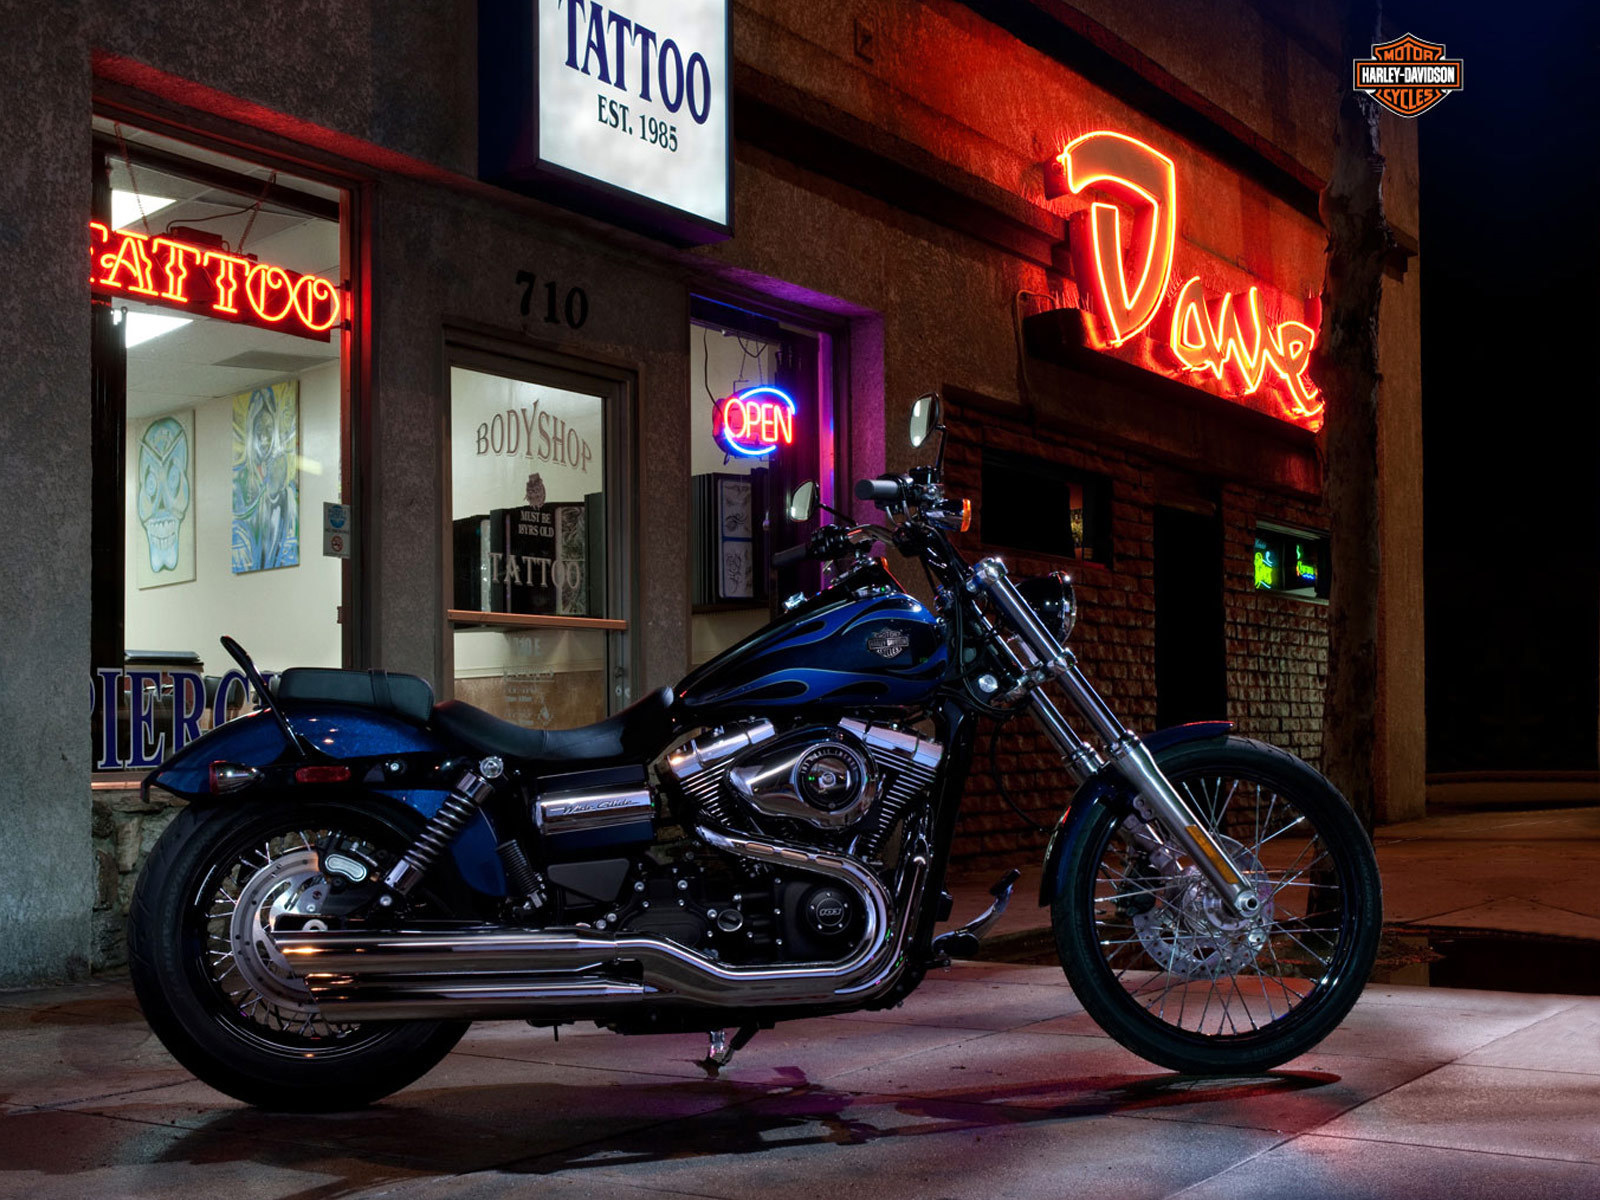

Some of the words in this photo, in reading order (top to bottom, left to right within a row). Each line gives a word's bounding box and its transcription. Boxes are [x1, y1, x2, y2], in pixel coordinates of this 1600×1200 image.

[558, 0, 712, 125] TATTOO
[597, 94, 633, 136] EST.
[639, 114, 678, 153] 1985
[516, 269, 588, 329] 710
[724, 398, 792, 443] OPEN
[520, 510, 540, 523] MUST
[541, 513, 551, 524] BE
[539, 526, 554, 538] OLD
[489, 552, 580, 589] TATTOO
